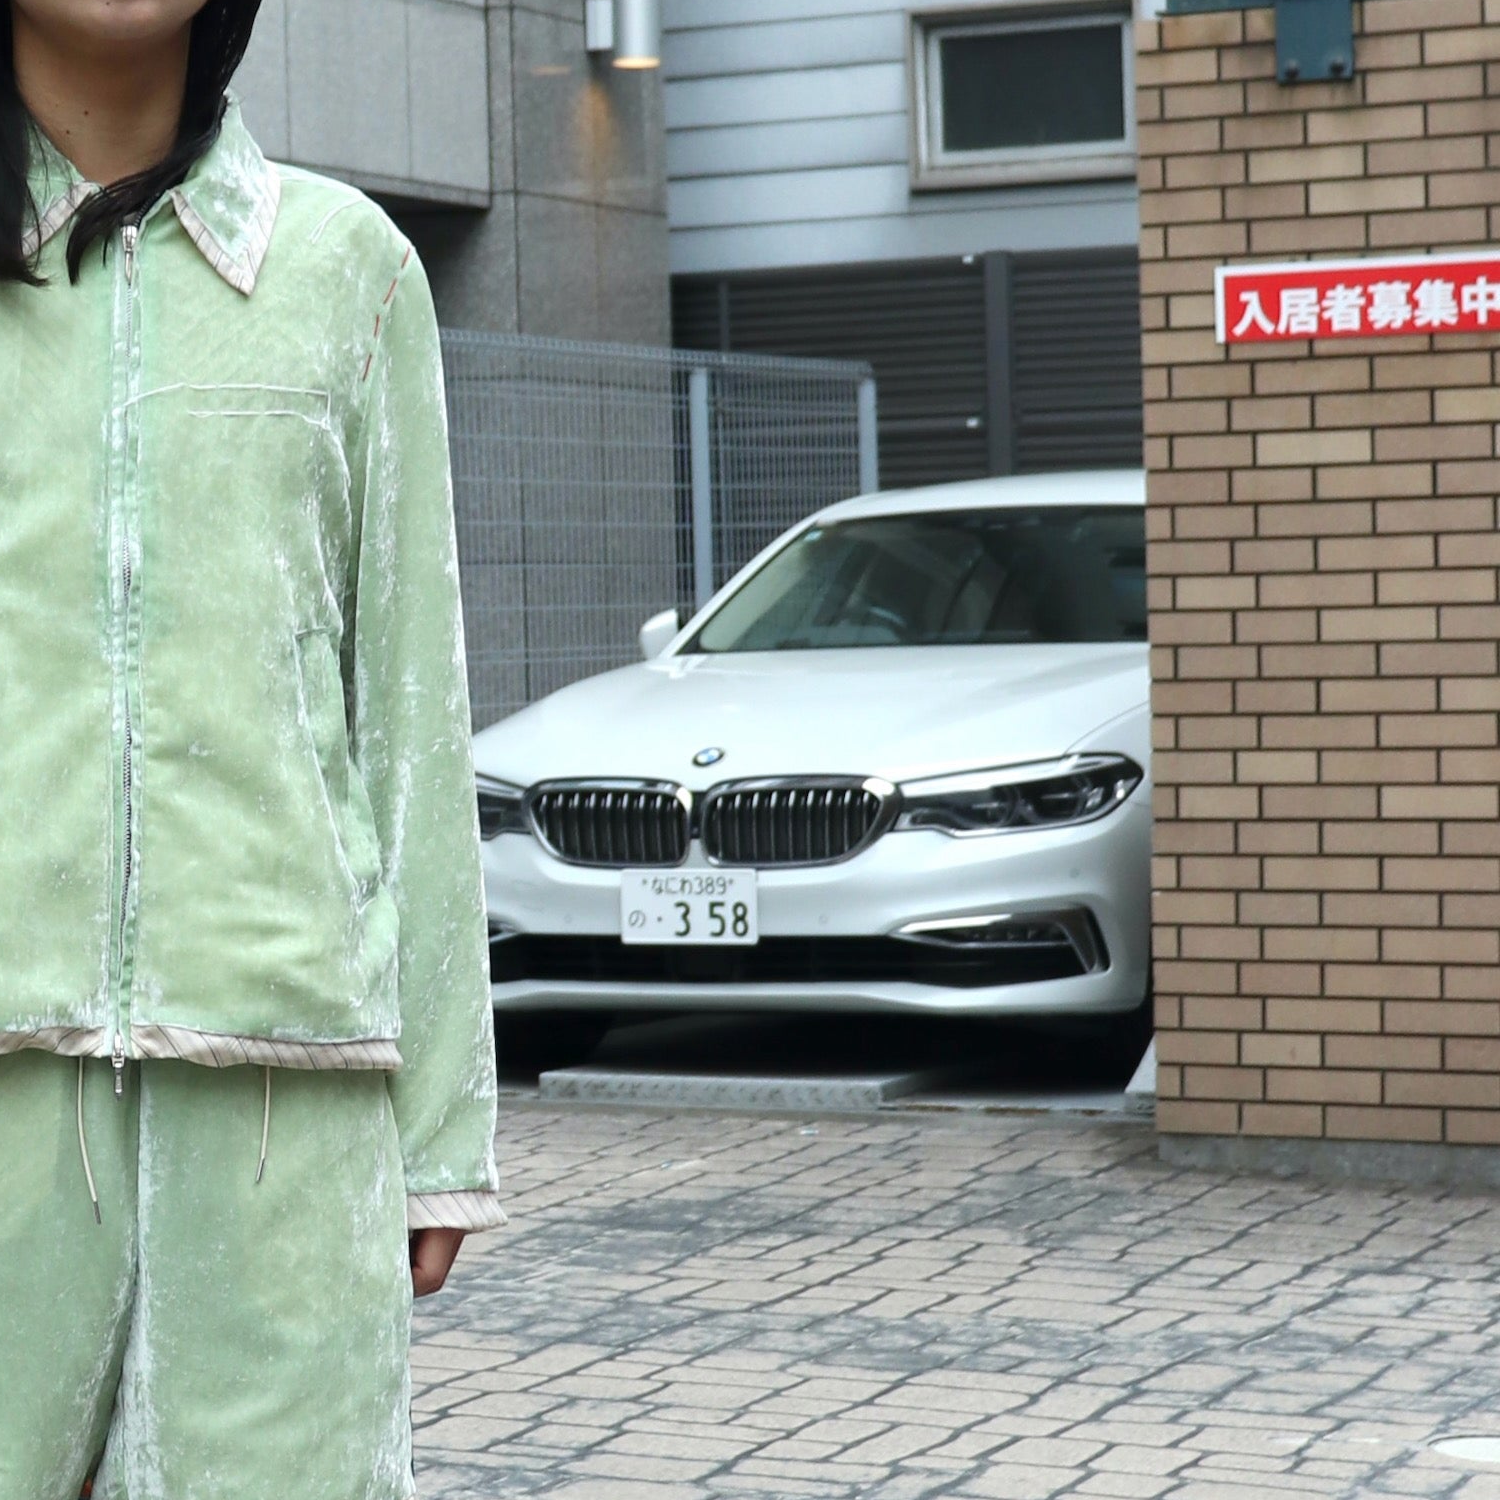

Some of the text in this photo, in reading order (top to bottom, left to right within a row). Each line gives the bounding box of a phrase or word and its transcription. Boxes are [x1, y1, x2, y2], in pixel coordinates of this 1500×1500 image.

[1232, 276, 1500, 337] 入居者募集中
